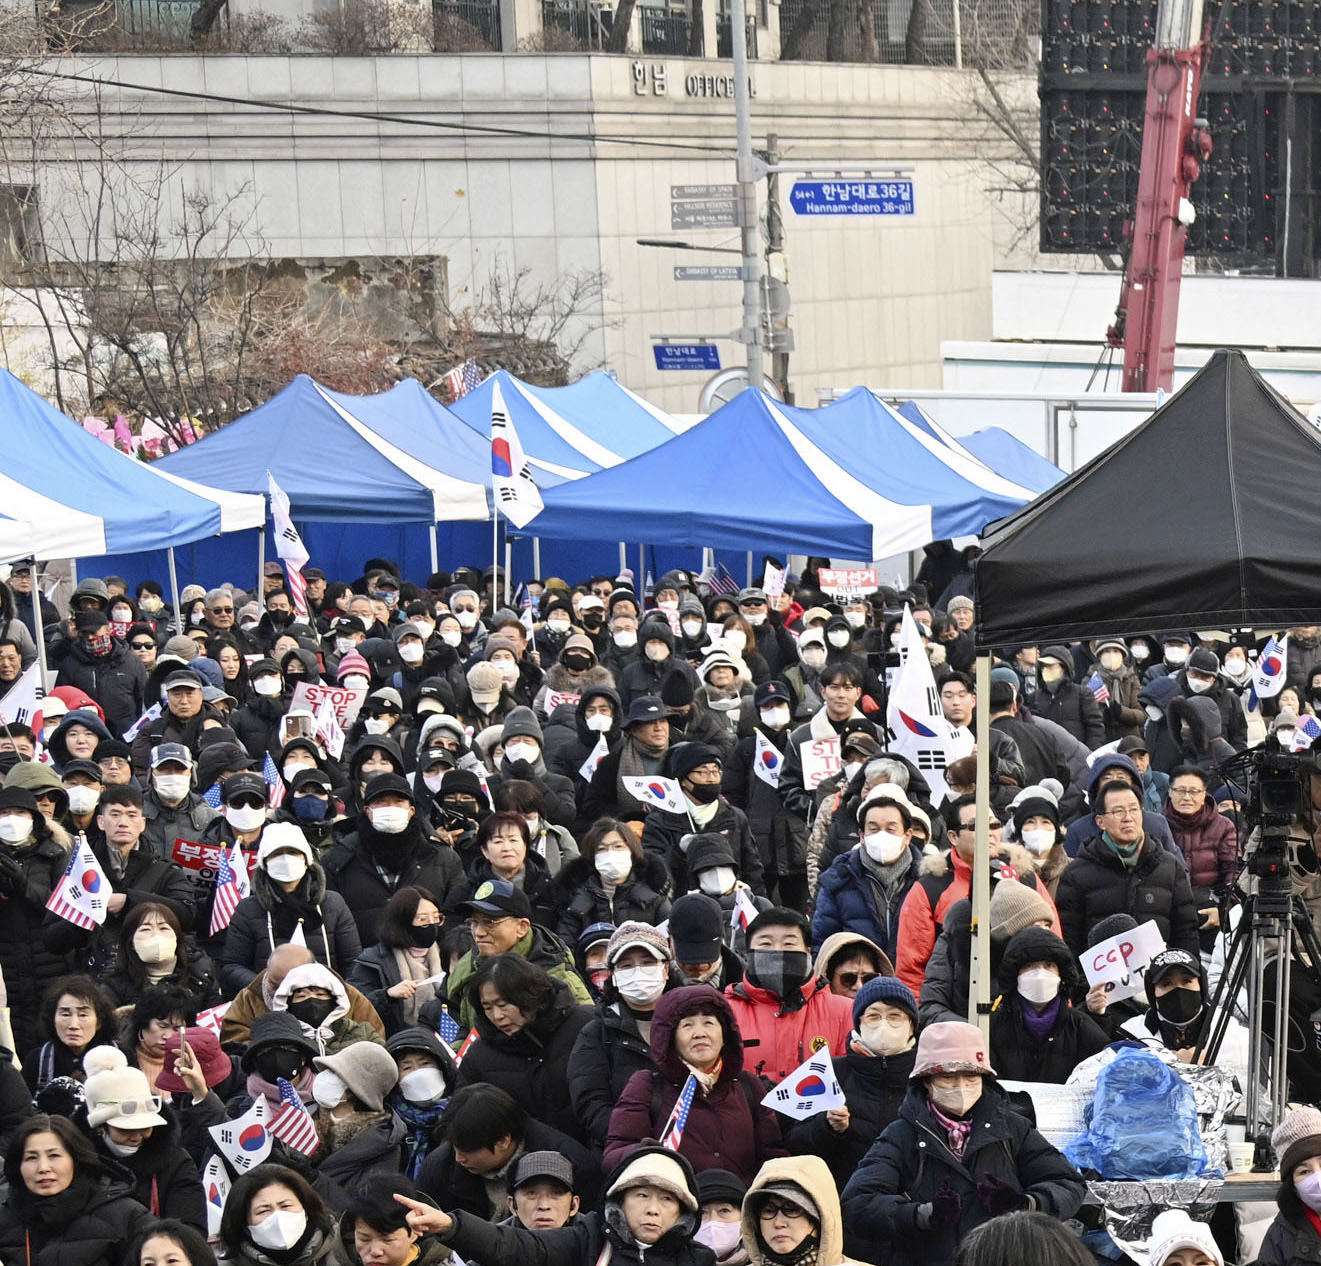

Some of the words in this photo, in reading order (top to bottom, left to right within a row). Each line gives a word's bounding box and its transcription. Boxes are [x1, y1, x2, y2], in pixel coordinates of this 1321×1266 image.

[633, 60, 668, 96] 한남
[822, 184, 912, 201] 한남대로36길
[806, 202, 881, 214] Hannam-daero
[883, 202, 912, 215] 36-gil
[821, 570, 874, 584] 부정선거
[305, 687, 357, 705] STOP
[310, 702, 348, 718] TE
[1104, 965, 1146, 993] OUT
